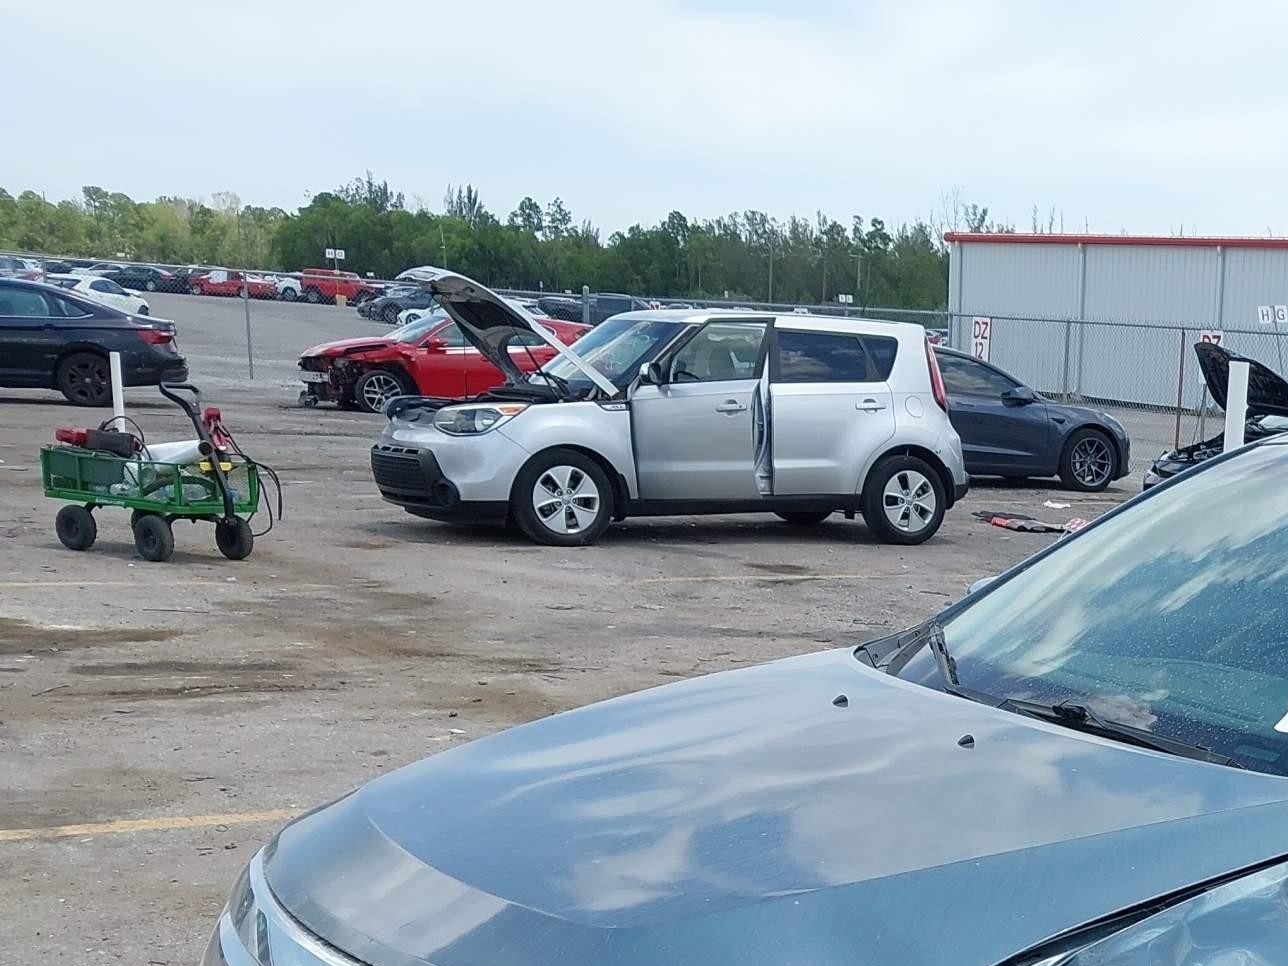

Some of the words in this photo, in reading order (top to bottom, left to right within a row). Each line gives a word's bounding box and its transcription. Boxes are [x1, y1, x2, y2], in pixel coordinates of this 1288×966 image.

[1261, 309, 1270, 321] H
[1276, 308, 1286, 321] G
[973, 320, 989, 340] DZ
[975, 341, 984, 360] 12
